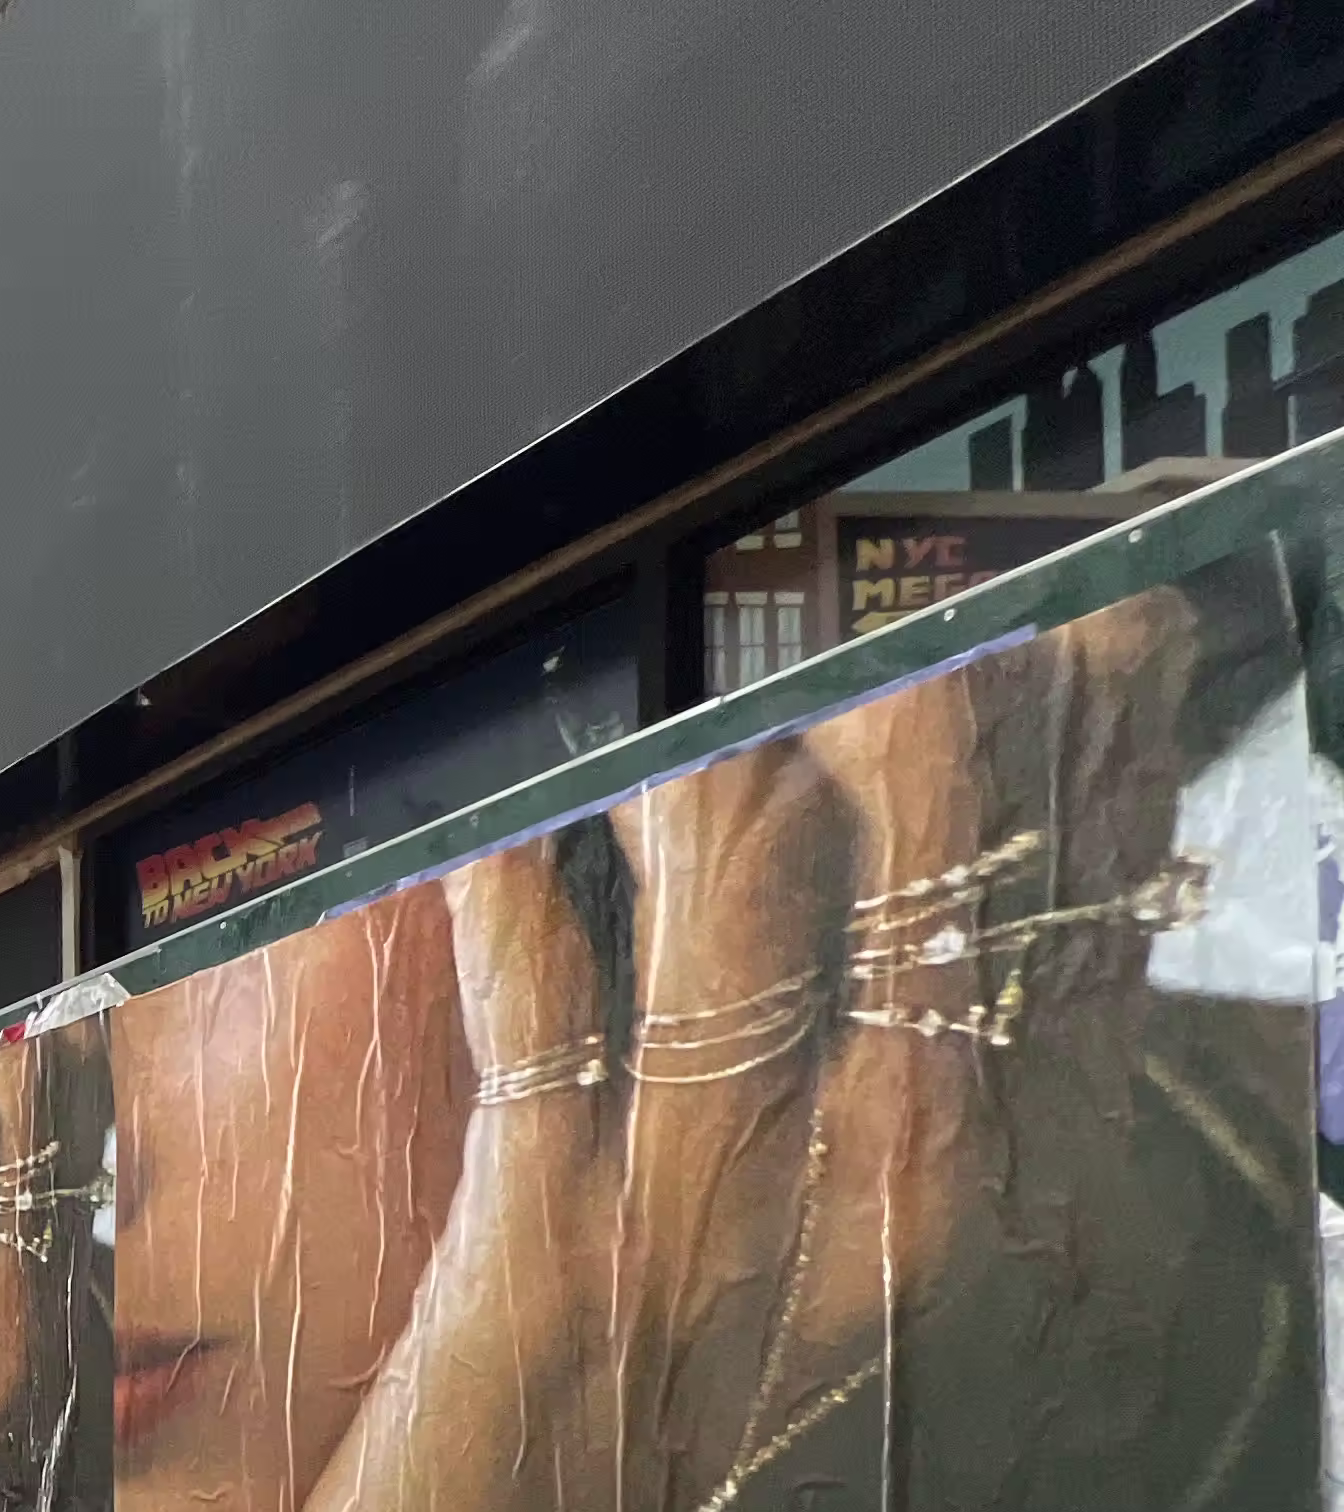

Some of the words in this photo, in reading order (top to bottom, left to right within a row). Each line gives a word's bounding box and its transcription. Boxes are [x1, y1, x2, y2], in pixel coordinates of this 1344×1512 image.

[136, 802, 322, 910] BACK
[143, 896, 169, 928] TO
[233, 830, 323, 892] YORK
